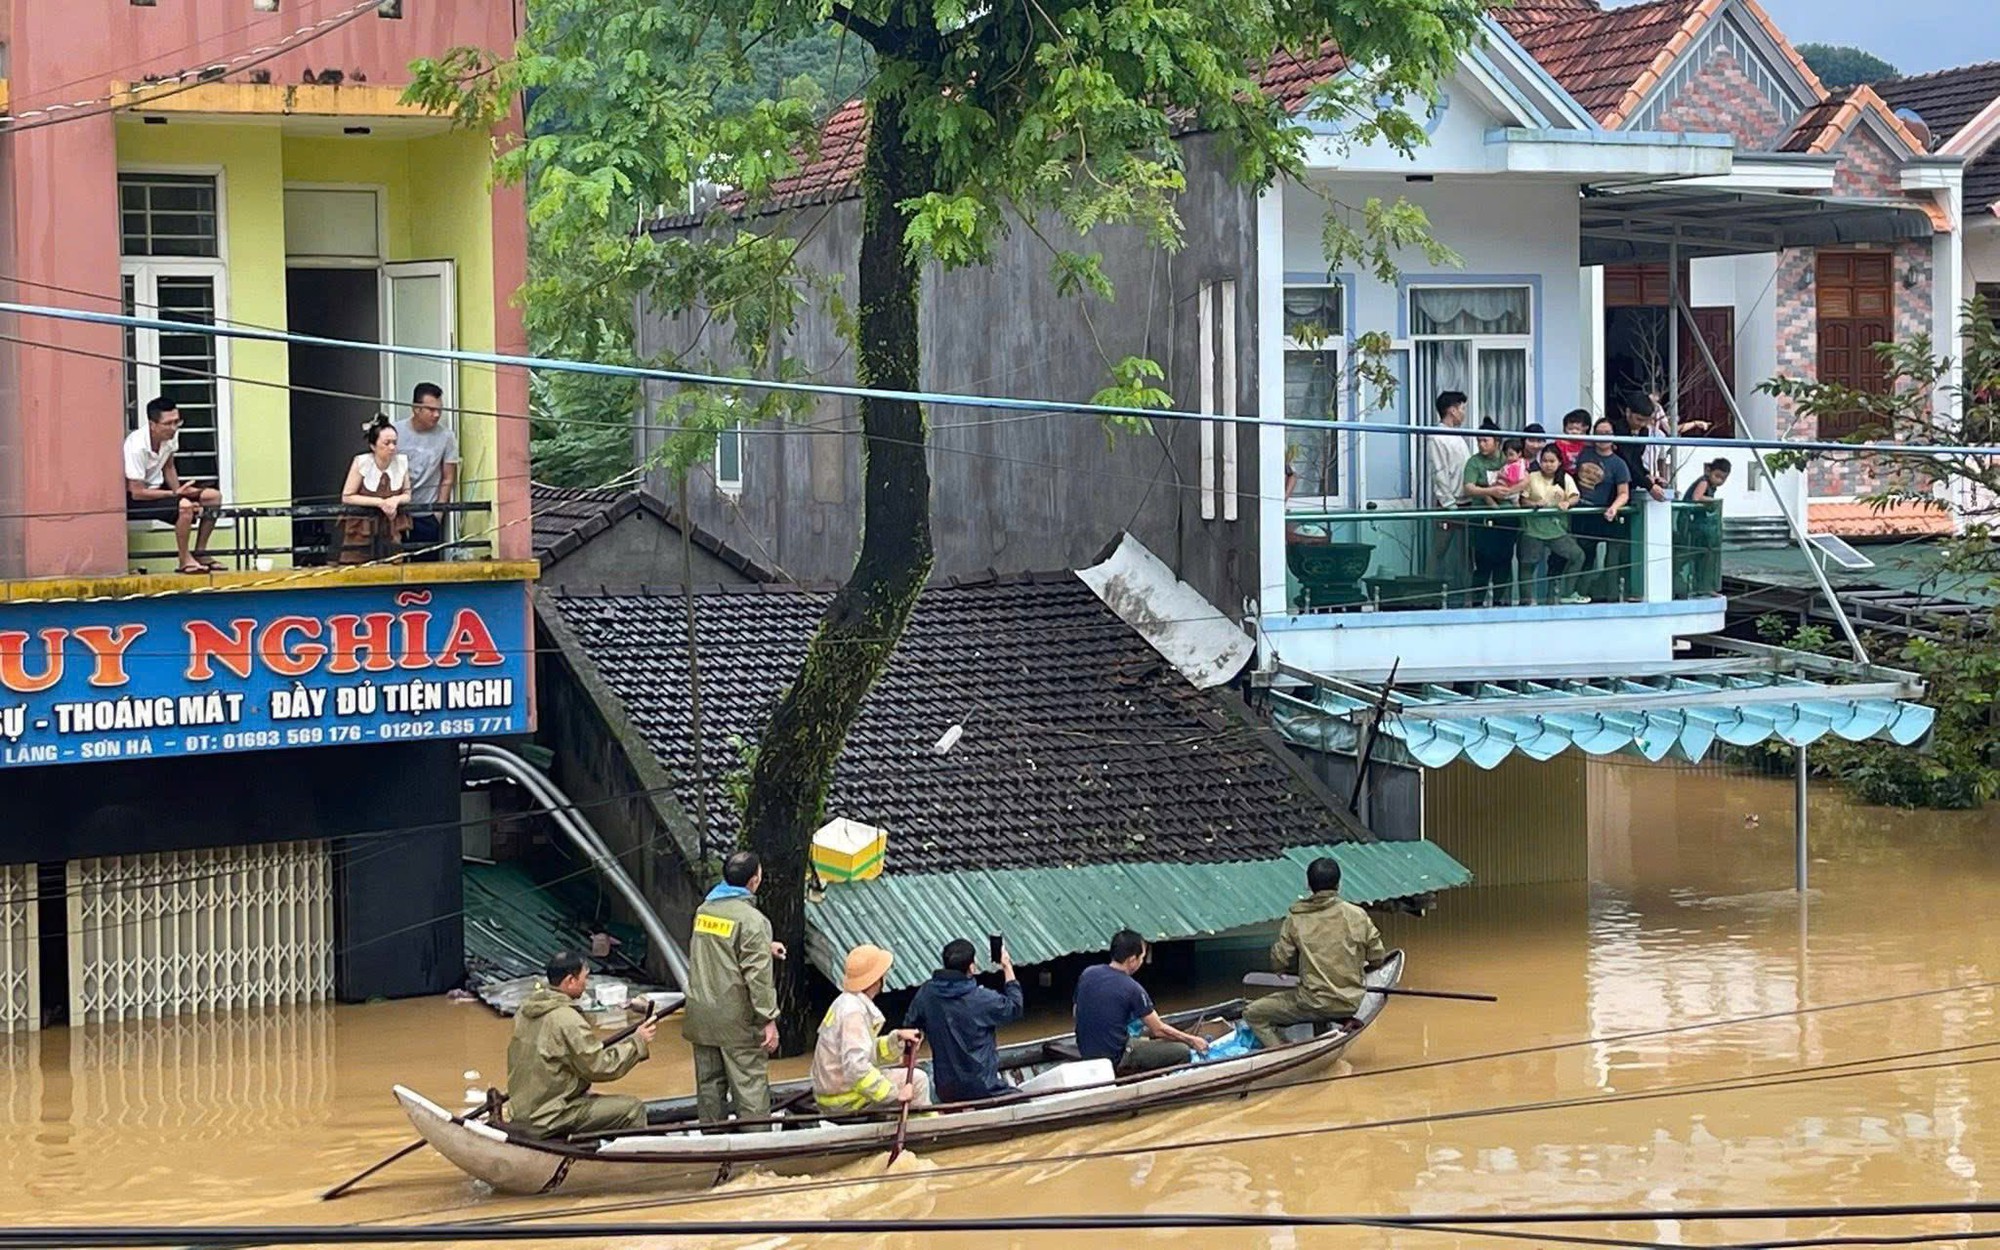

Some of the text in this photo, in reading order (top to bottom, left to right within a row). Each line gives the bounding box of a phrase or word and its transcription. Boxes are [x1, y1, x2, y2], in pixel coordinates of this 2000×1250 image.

[0, 590, 506, 693] UY NGHĨA
[0, 703, 28, 743] Ự
[54, 696, 175, 733] THOÁNG
[179, 690, 244, 726] MÁT
[271, 680, 327, 719] ĐẦY
[336, 679, 377, 715] ĐỦ
[382, 679, 442, 716] TIỆN
[447, 678, 513, 710] NGHI
[80, 739, 121, 759] SƠN
[222, 731, 281, 750] 01693
[286, 727, 324, 745] 569
[328, 725, 361, 742] 176
[479, 716, 512, 732] 771
